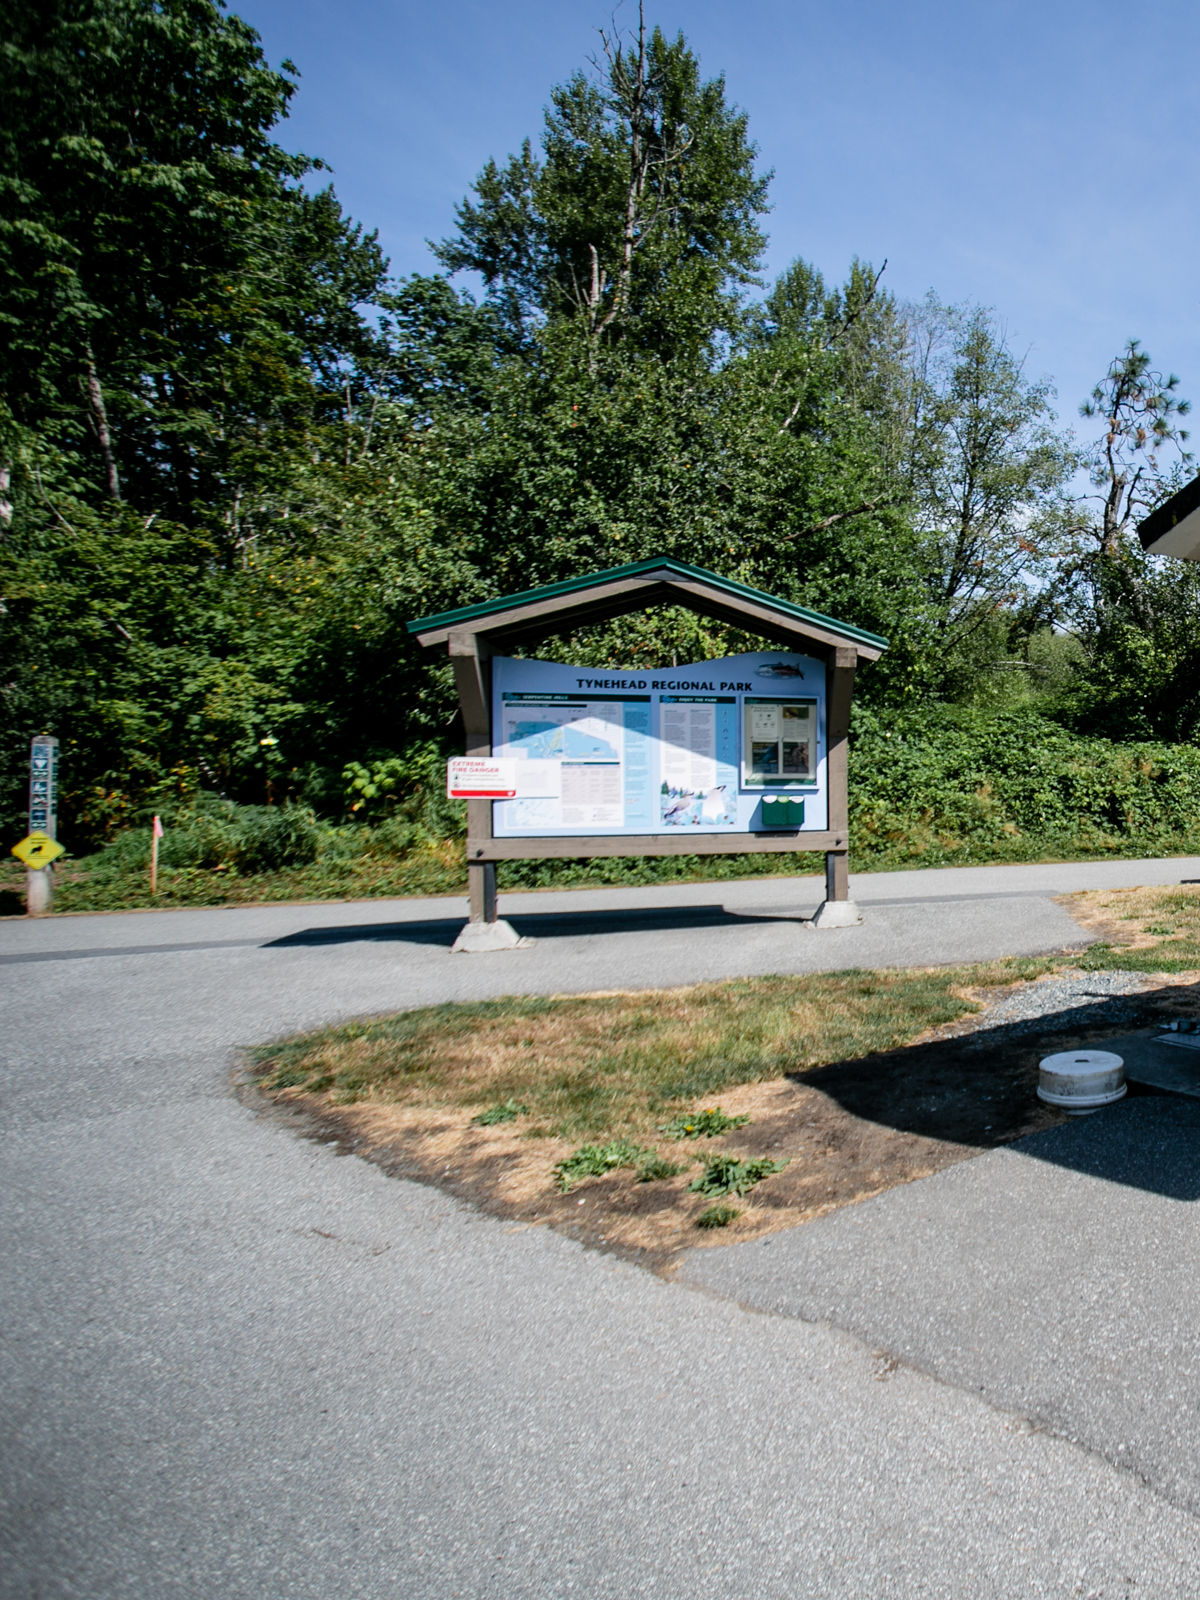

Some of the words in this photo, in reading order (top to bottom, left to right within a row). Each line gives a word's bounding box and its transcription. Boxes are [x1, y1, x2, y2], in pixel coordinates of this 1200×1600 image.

[576, 679, 647, 690] TYNEHEAD
[651, 680, 716, 691] REGIONAL
[720, 682, 752, 692] PARK
